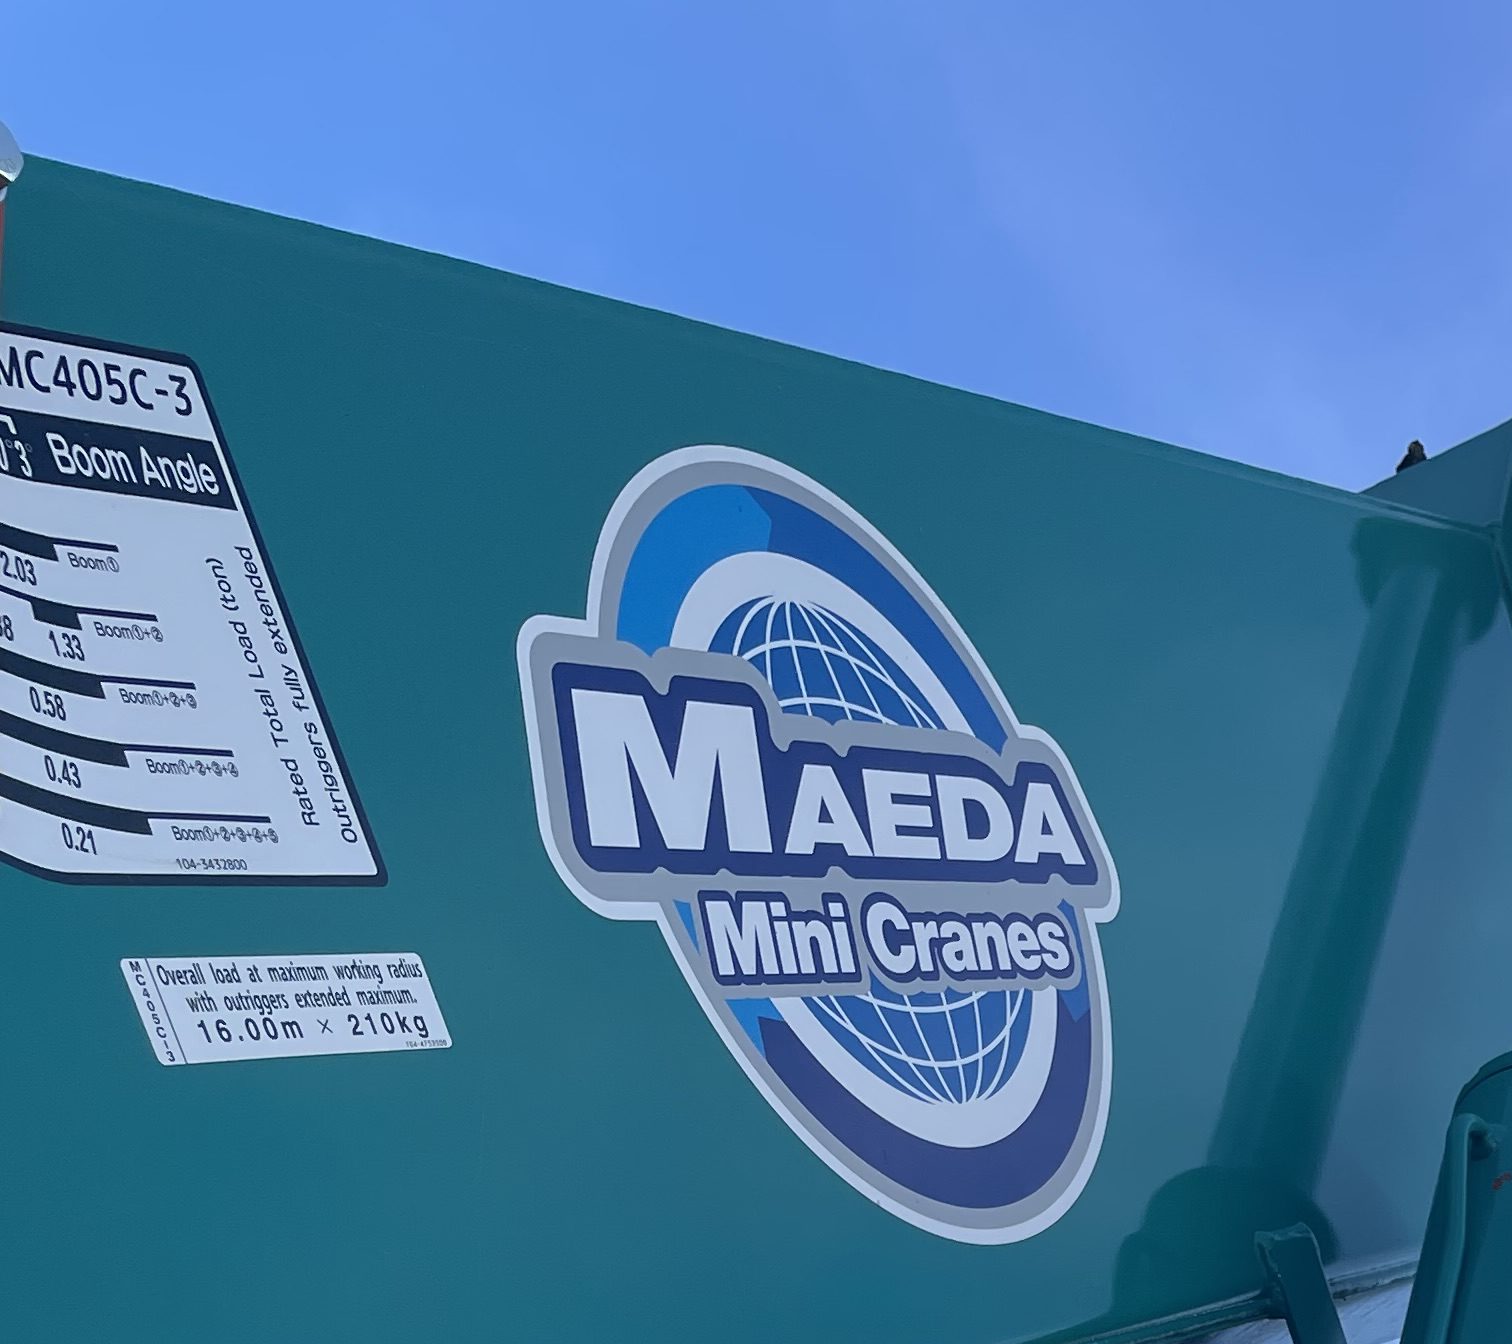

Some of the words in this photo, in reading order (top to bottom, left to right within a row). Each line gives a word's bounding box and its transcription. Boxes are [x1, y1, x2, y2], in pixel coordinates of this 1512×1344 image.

[0, 346, 192, 416] MC405C-3
[46, 432, 138, 483] Boom
[140, 446, 220, 495] Angle
[1, 552, 37, 586] 2.03
[205, 558, 240, 612] (ton)
[234, 545, 288, 655] extended
[49, 630, 85, 661] 1.33
[229, 620, 265, 679] Load
[30, 686, 66, 721] 0.58
[281, 663, 310, 711] fully
[254, 689, 289, 749] Total
[44, 754, 82, 788] 0.43
[280, 758, 320, 826] Rated
[304, 721, 358, 844] Outriggers
[570, 688, 1087, 867] MAEDA
[61, 822, 98, 856] 0.21
[706, 898, 857, 979] Mini
[865, 899, 1072, 975] Cranes
[156, 962, 206, 986] Overall
[208, 961, 242, 985] load
[246, 964, 263, 983] at
[267, 960, 330, 983] maximum
[332, 958, 384, 985] working
[386, 957, 423, 980] radius
[186, 990, 218, 1013] with
[223, 988, 290, 1016] outriggers
[294, 985, 352, 1009] extended
[197, 1017, 304, 1043] 16.00m
[347, 1010, 429, 1039] 210kg
